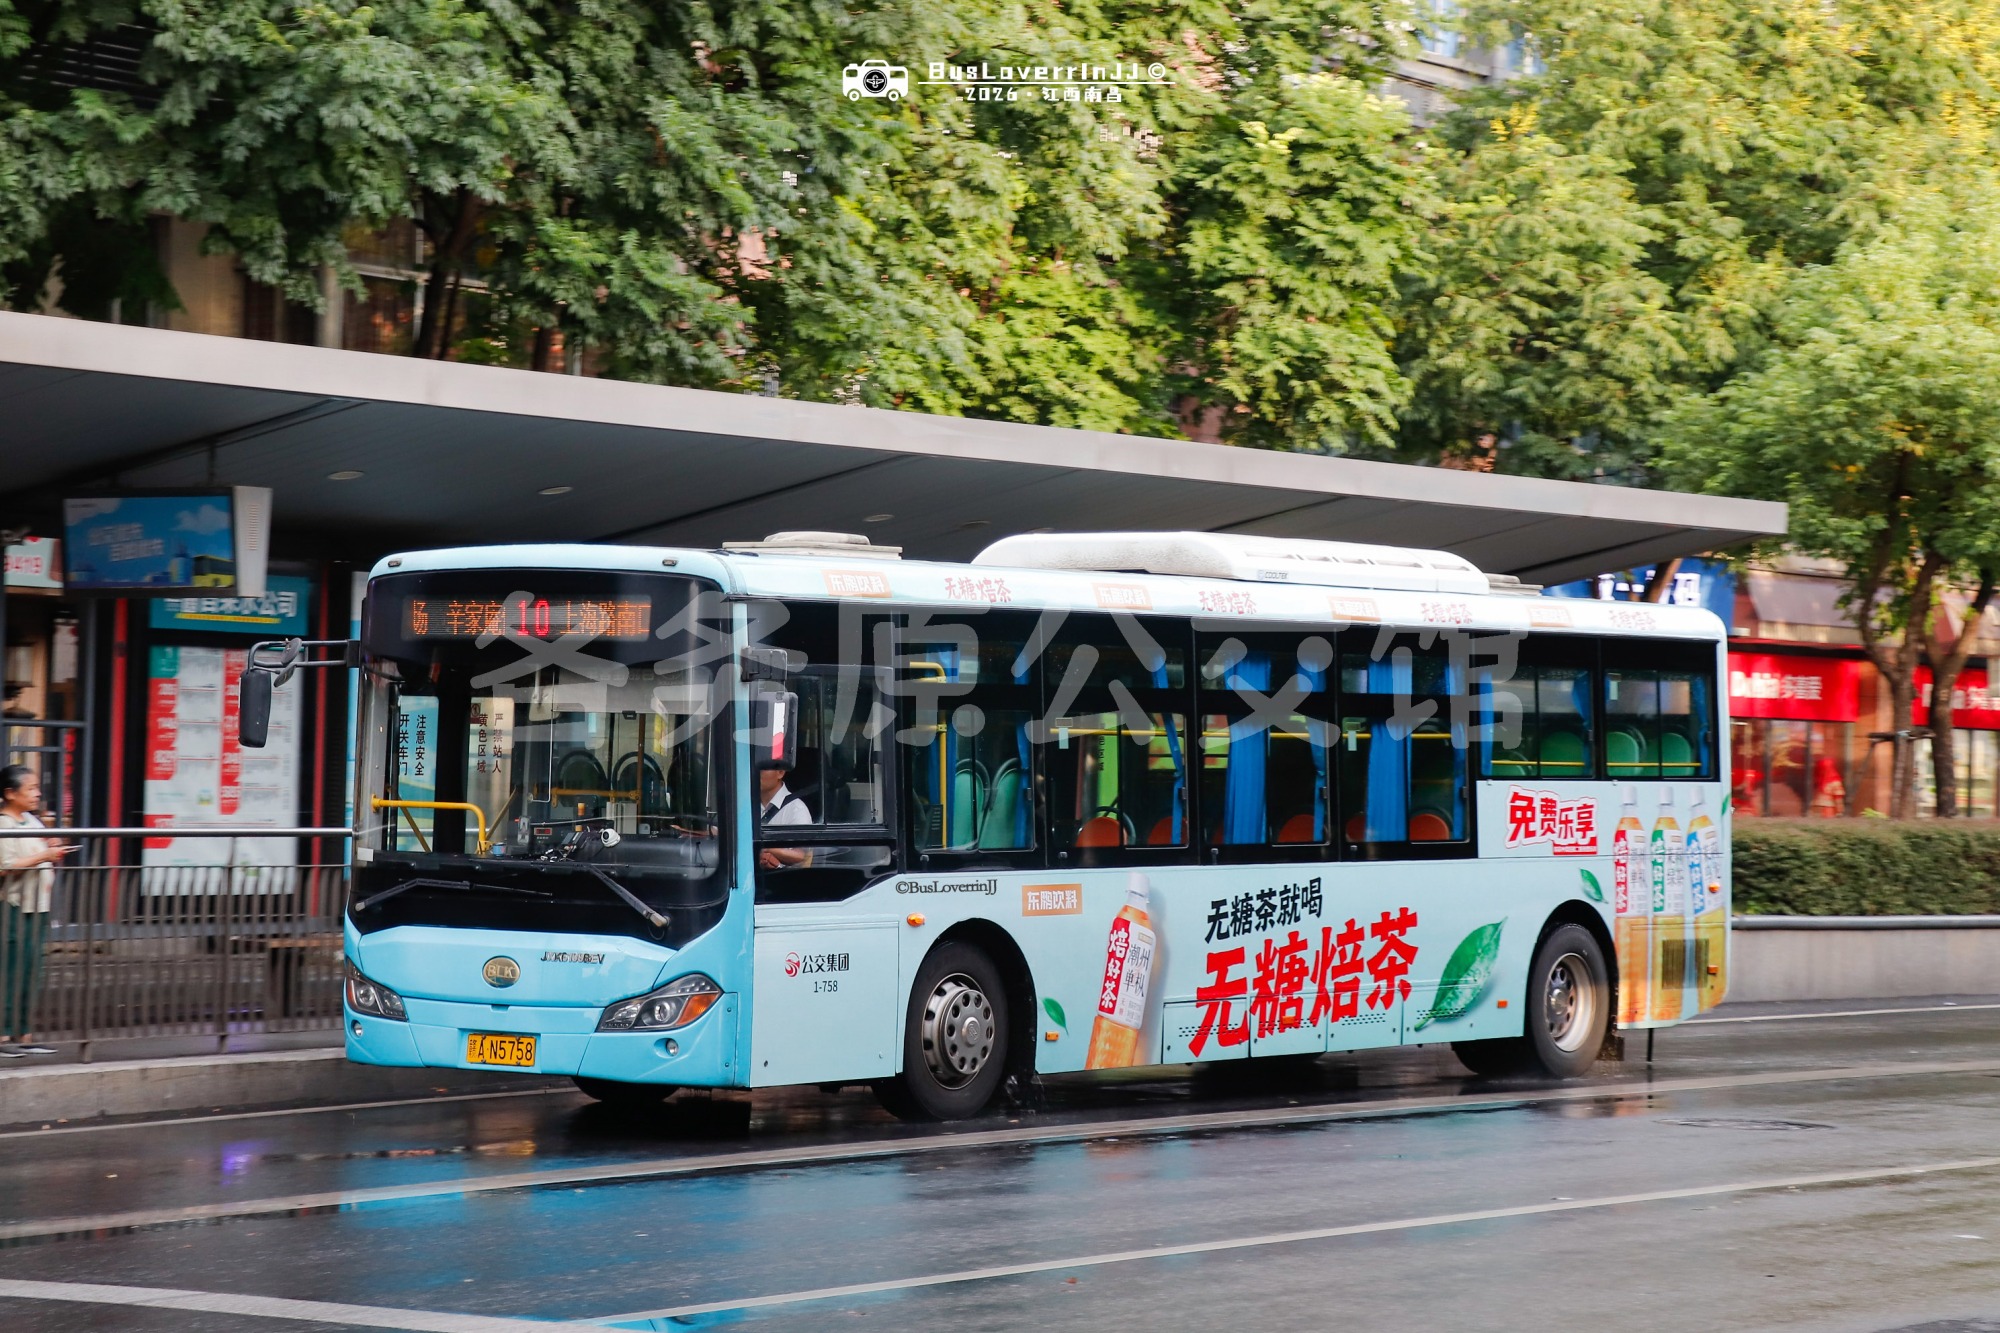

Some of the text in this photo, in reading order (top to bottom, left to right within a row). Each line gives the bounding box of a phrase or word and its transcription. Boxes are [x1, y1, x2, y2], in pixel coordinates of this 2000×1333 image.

[516, 600, 551, 636] 10
[944, 576, 1012, 603] 无糖焙茶
[399, 713, 410, 776] 开关车门
[414, 714, 427, 777] 注意安全
[476, 713, 489, 773] 黄色区域
[492, 713, 504, 774] 严禁站人
[1509, 791, 1595, 842] 免费乐享
[1027, 889, 1078, 911] 东鹏饮料
[1204, 876, 1323, 944] 无糖茶就喝
[802, 953, 849, 974] 公交集团
[813, 980, 838, 993] 1-758
[1101, 927, 1129, 1009] 焙好茶
[1188, 906, 1419, 1058] 无糖焙茶
